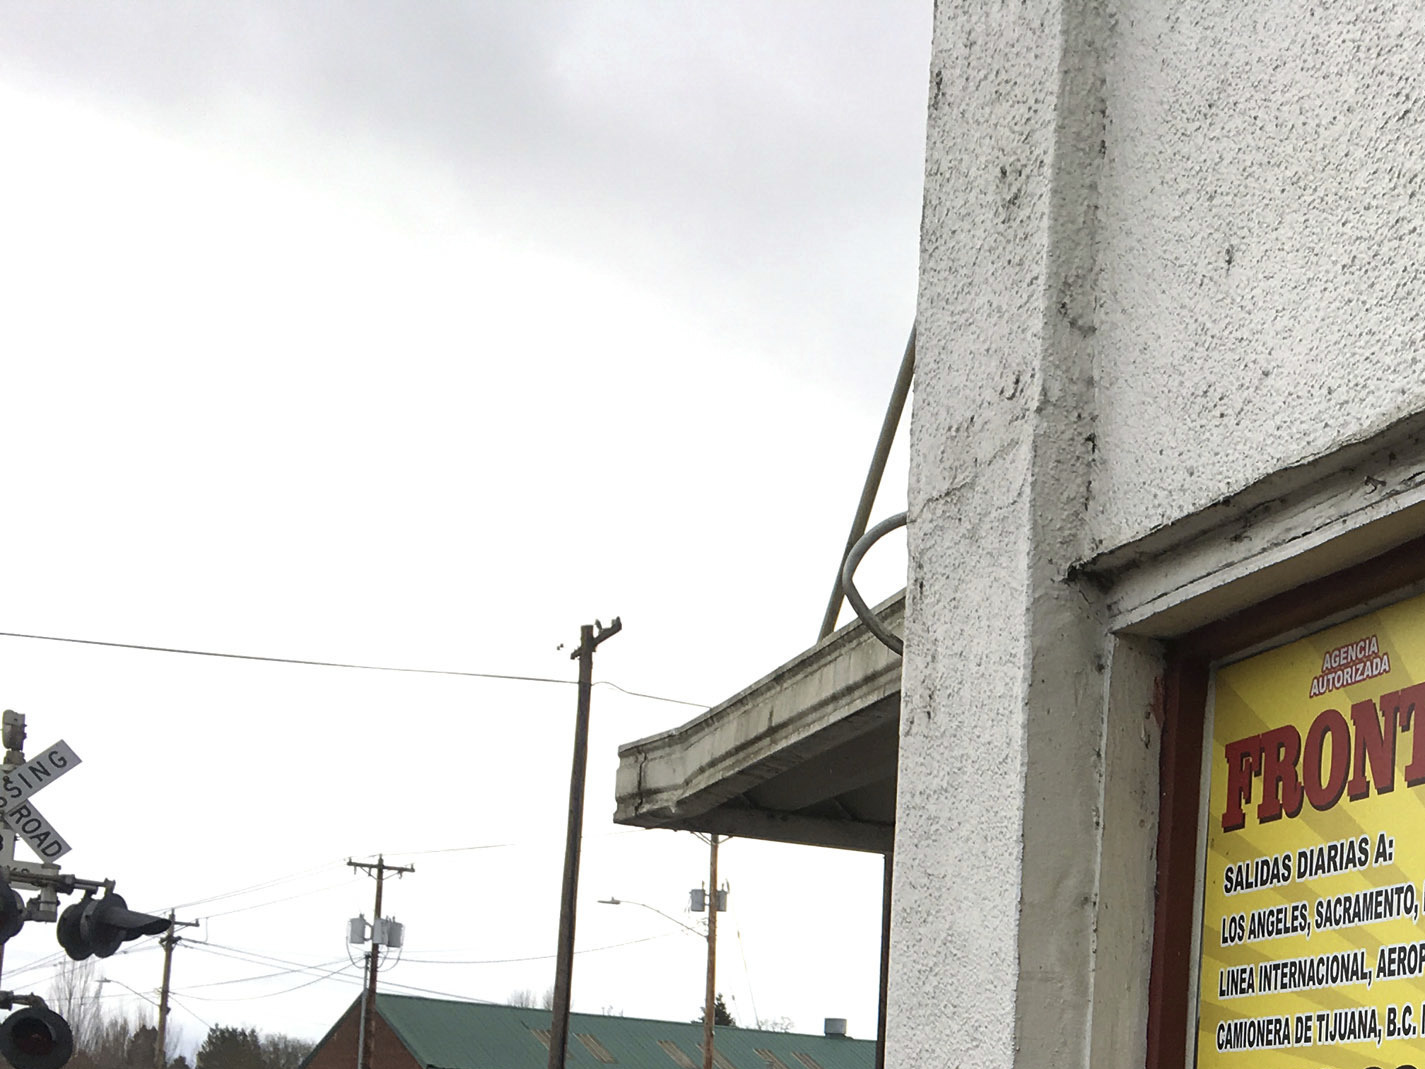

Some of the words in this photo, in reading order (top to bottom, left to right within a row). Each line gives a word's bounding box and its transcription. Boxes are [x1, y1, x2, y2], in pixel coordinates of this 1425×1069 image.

[1310, 655, 1390, 697] AUTORIZADA
[1322, 635, 1379, 672] AGENCIA
[9, 804, 62, 857] ROAD
[1224, 853, 1292, 894] SALIDAS
[1296, 840, 1369, 881] DIARIAS
[1373, 834, 1394, 866] A:
[1221, 912, 1245, 944] LOS
[1247, 906, 1312, 941] ANGELES,
[1314, 885, 1420, 932] SACRAMENTO,
[1219, 962, 1255, 998] LINEA
[1258, 949, 1373, 994] INTERNACIONAL,
[1216, 1012, 1291, 1052] CAMIONERA
[1294, 1012, 1314, 1044] DE
[1316, 1006, 1383, 1046] TIJUANA,
[1386, 1003, 1416, 1036] B.C.
